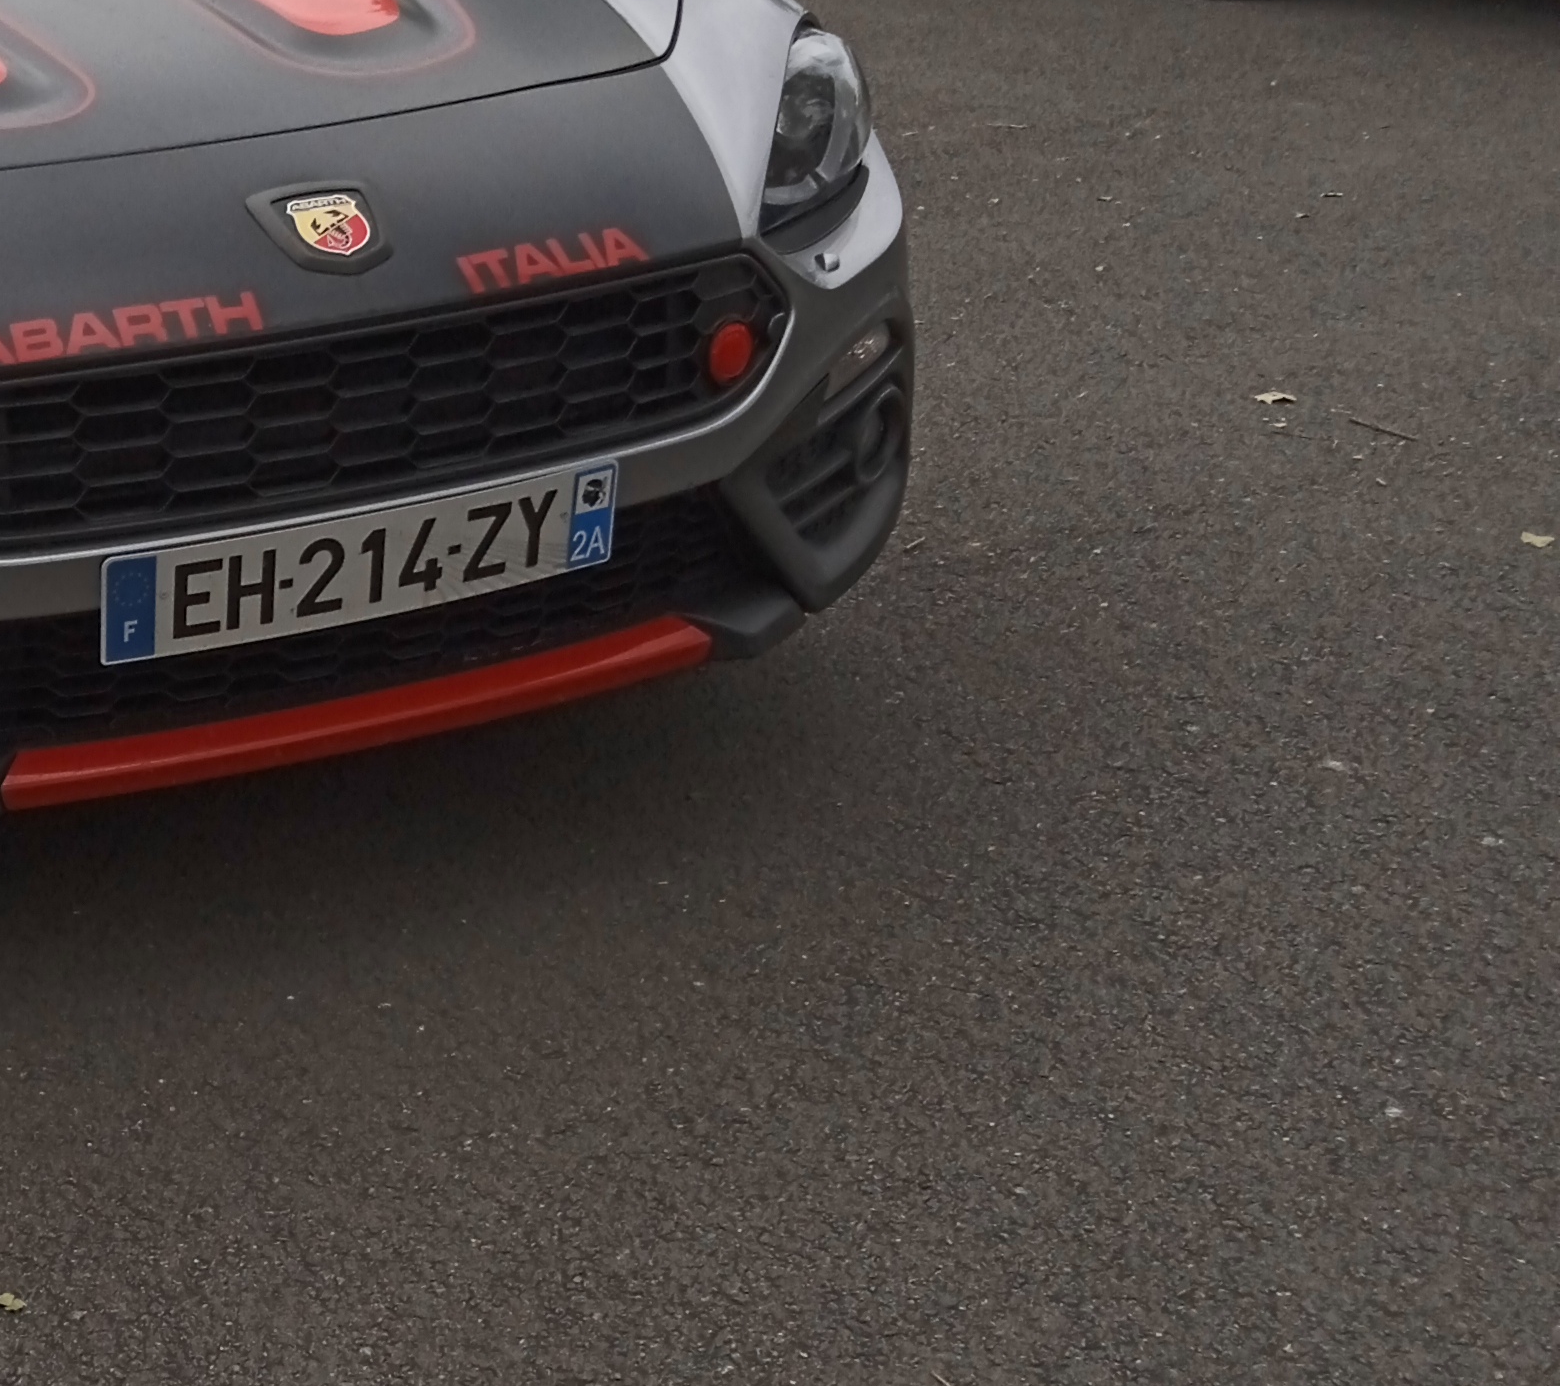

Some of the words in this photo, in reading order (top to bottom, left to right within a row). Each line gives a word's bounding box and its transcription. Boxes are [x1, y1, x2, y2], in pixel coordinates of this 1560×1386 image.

[291, 197, 350, 211] ABARTH
[455, 227, 650, 294] ITALIA
[571, 525, 605, 562] 2A
[172, 489, 558, 640] EH-214-ZY
[123, 619, 138, 643] F
